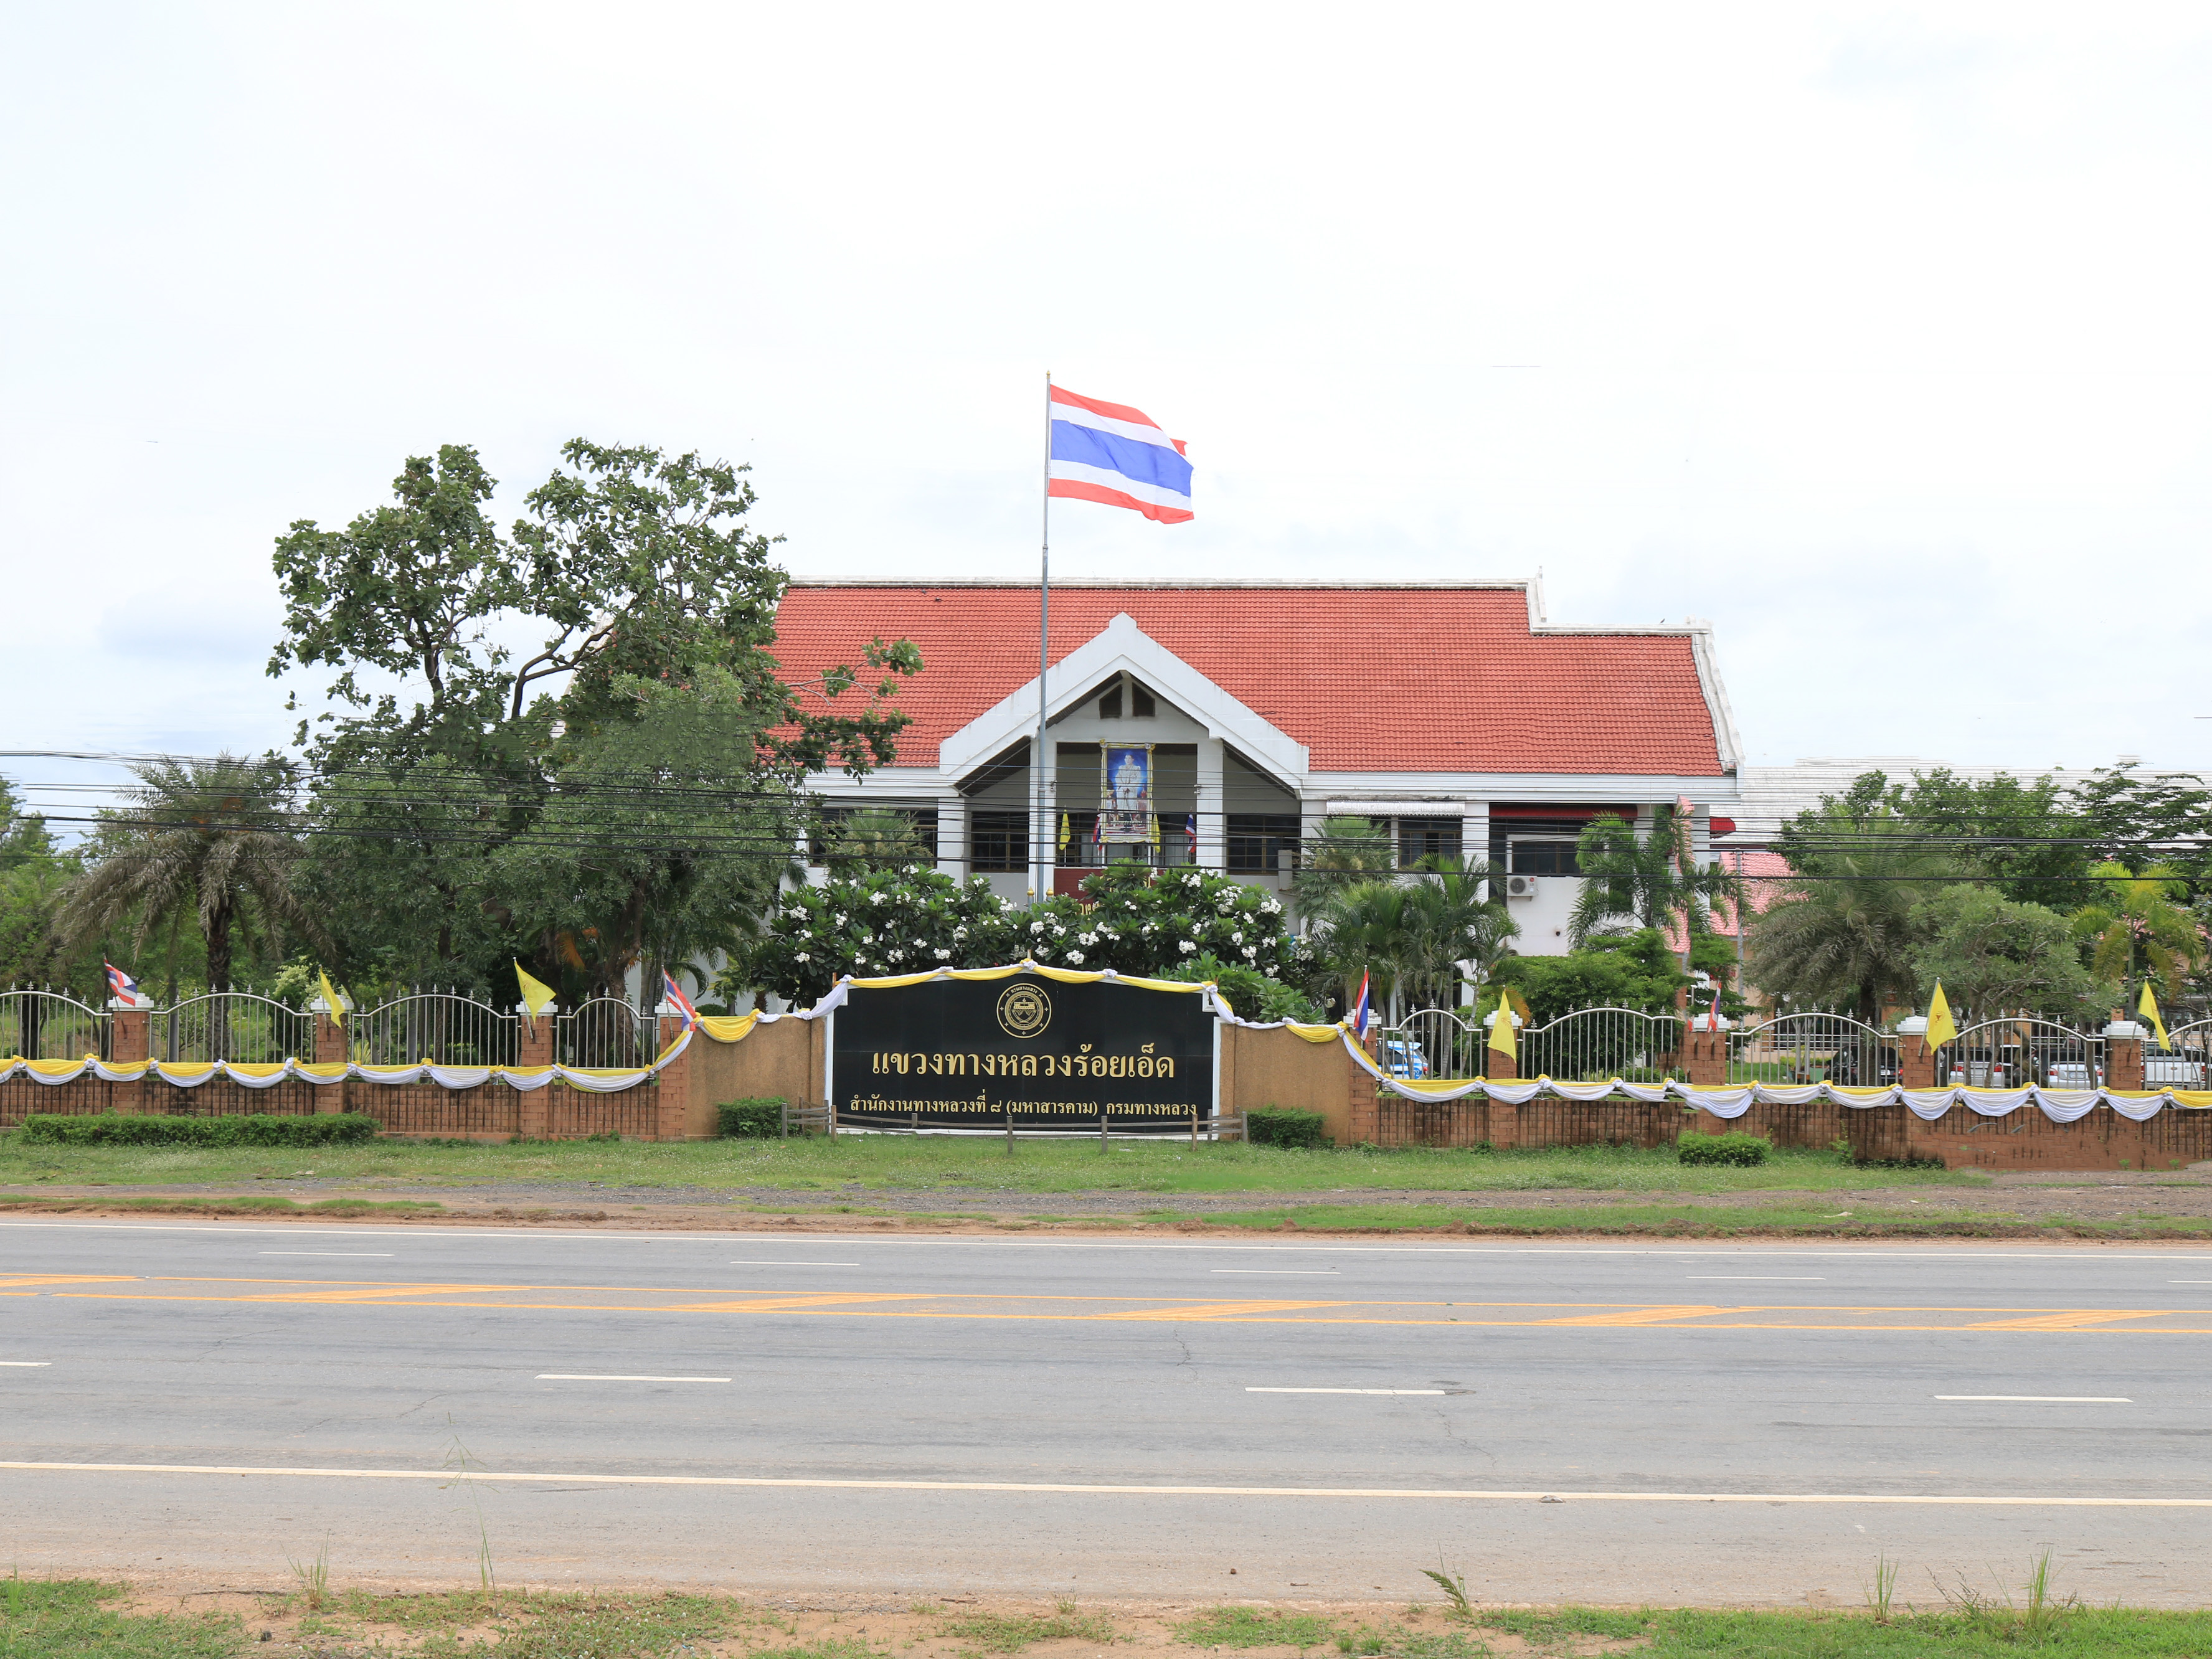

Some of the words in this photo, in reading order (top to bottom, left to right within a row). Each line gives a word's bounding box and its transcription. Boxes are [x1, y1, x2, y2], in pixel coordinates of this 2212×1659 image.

[872, 1042, 1174, 1078] แขวงทางหลวงร้อยเอ็ด
[850, 1089, 986, 1113] สำนักงานทางหลวงที่
[990, 1100, 1003, 1113] ๘
[1006, 1100, 1098, 1116] (มหาสารคาม)
[1106, 1102, 1197, 1115] กรมทางหลวง
